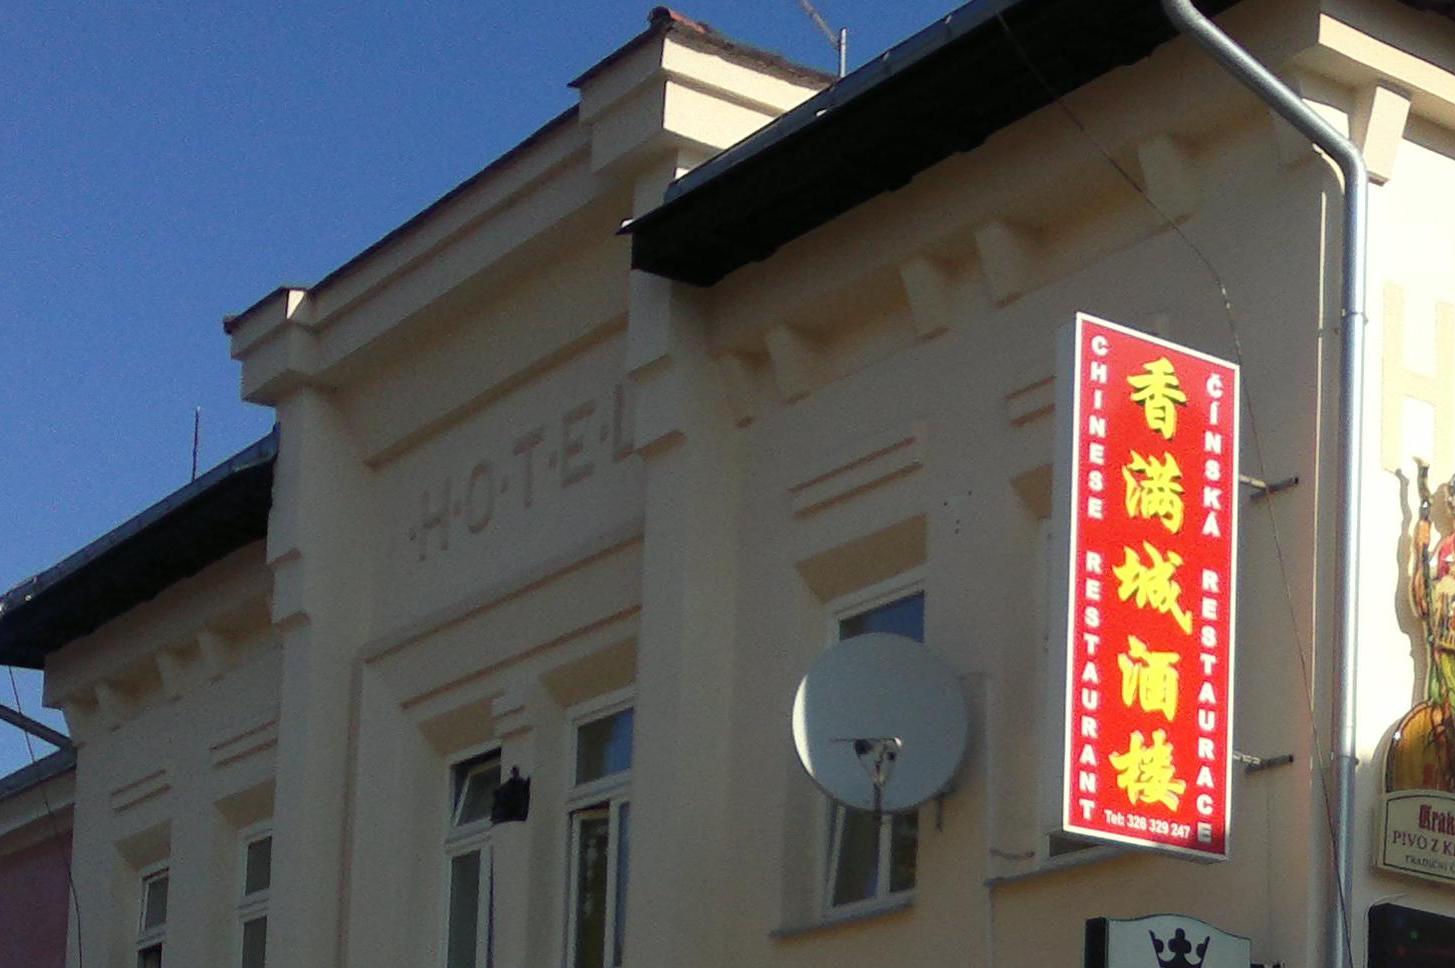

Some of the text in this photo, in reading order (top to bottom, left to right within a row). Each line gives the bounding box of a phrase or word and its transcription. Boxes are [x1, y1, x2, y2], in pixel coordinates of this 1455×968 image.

[1087, 335, 1109, 519] CHINESE
[1078, 551, 1104, 820] RESTAURANT
[1196, 569, 1220, 842] RESTAURACE
[1171, 823, 1191, 839] 247
[1392, 830, 1428, 850] PIVO
[1430, 838, 1439, 853] Z
